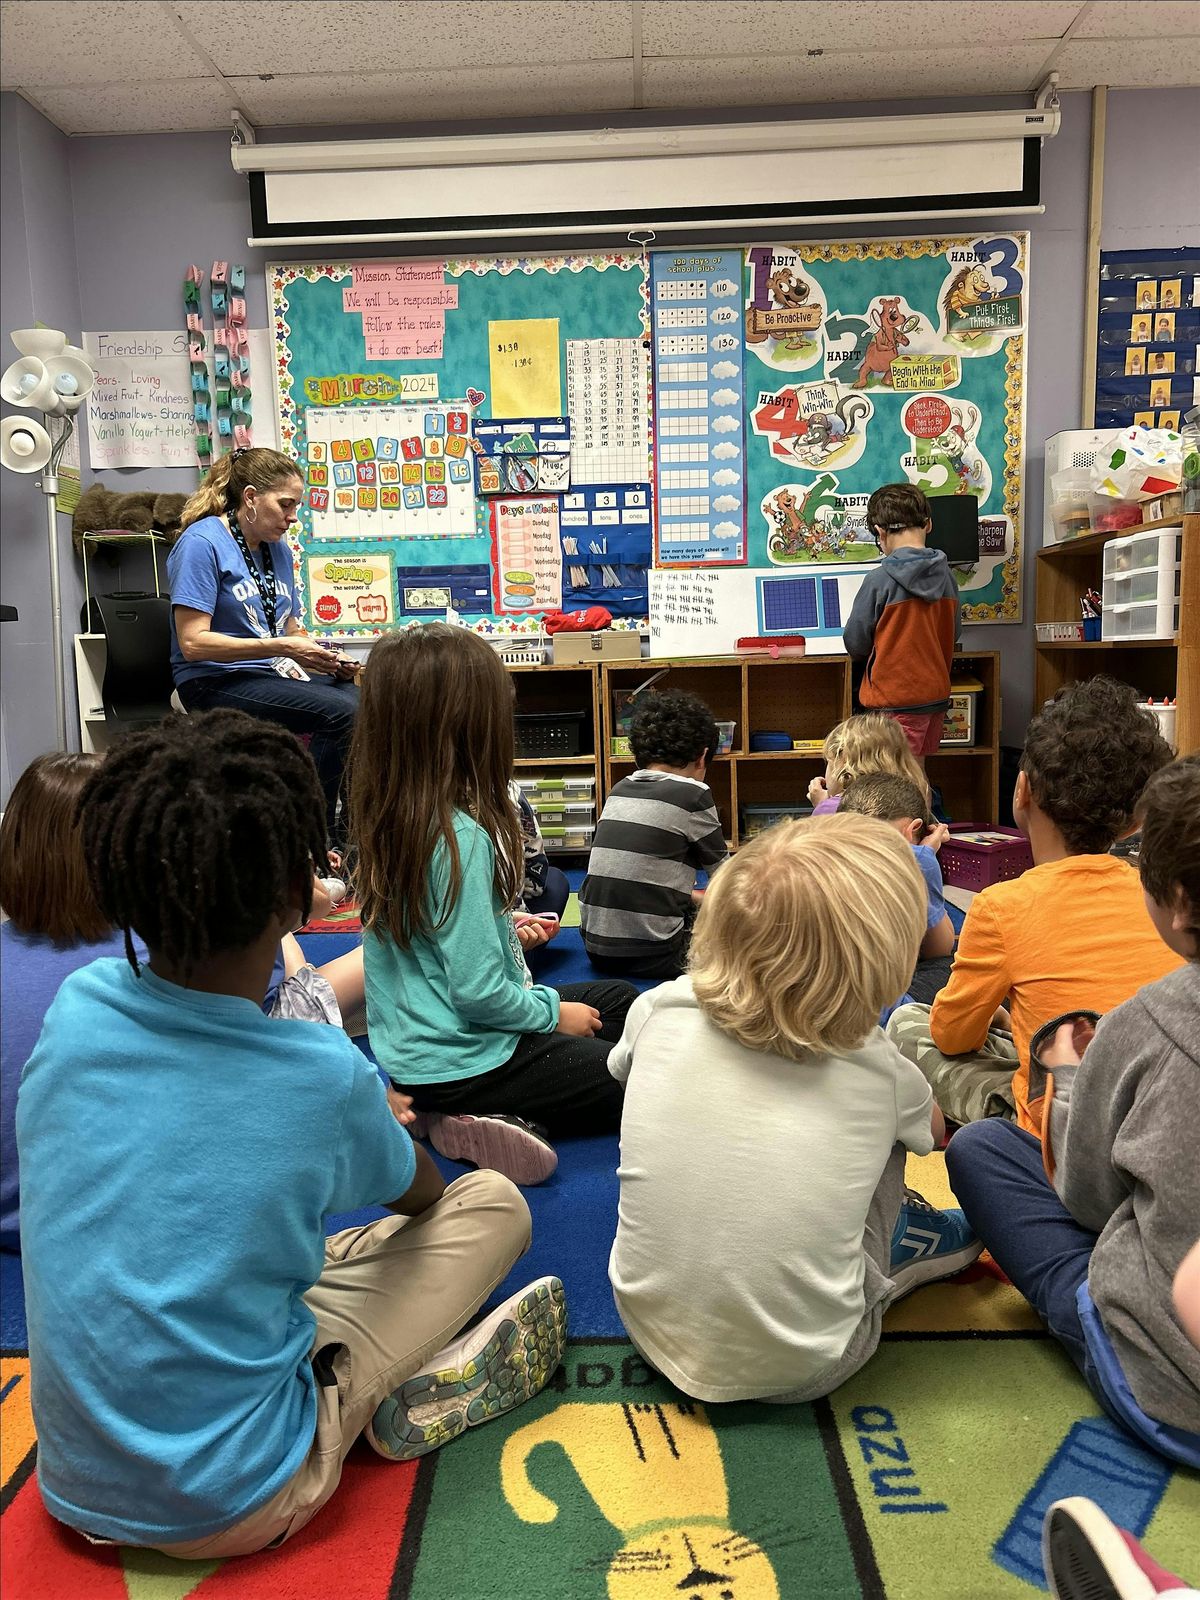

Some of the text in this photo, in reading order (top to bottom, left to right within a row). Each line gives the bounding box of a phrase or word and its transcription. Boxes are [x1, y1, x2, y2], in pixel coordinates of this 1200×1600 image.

[690, 258, 709, 266] days
[762, 256, 796, 266] HABIT
[951, 252, 987, 262] HABIT
[355, 265, 442, 282] Mission Statement
[716, 284, 727, 293] 110
[345, 290, 456, 309] We will be responsible,
[717, 312, 731, 320] 120
[975, 303, 1009, 316] Put First
[365, 315, 444, 332] follow the rules,
[765, 313, 812, 325] Be Proactive
[969, 314, 1015, 328] Things First
[98, 335, 163, 360] Friendship
[379, 340, 389, 356] do
[396, 346, 411, 355] our
[416, 340, 442, 355] best!
[718, 339, 734, 348] 130
[827, 351, 862, 362] HABIT
[893, 364, 941, 378] Begin With the
[131, 370, 160, 389] Loving
[896, 376, 935, 388] End in Mind
[321, 376, 436, 401] March 2024
[805, 388, 827, 401] Think
[92, 390, 118, 403] Mixed
[149, 389, 190, 404] Kindness
[760, 394, 794, 408] HABIT
[802, 398, 833, 414] Win-Win
[914, 402, 927, 410] Seek
[160, 408, 196, 426] Sharing
[431, 417, 438, 432] 1
[454, 416, 462, 430] 2
[92, 424, 124, 440] Vanilla
[912, 426, 942, 434] Understood
[160, 443, 181, 456] Fun
[313, 440, 460, 459] 3 4 5 6 7 8 9
[904, 456, 939, 466] HABIT
[311, 464, 466, 481] 10 11 12 13 14 15 16
[482, 475, 499, 489] 23
[312, 490, 446, 506] 17 18 19 20 21 22
[573, 494, 639, 506] 1 3 0
[835, 497, 868, 507] HABIT
[501, 505, 524, 517] Days
[532, 503, 558, 514] Week
[847, 516, 868, 529] Synerg
[986, 536, 1003, 546] Saw
[324, 563, 373, 585] Spring
[320, 604, 337, 613] sunny
[850, 1405, 949, 1514] azul
